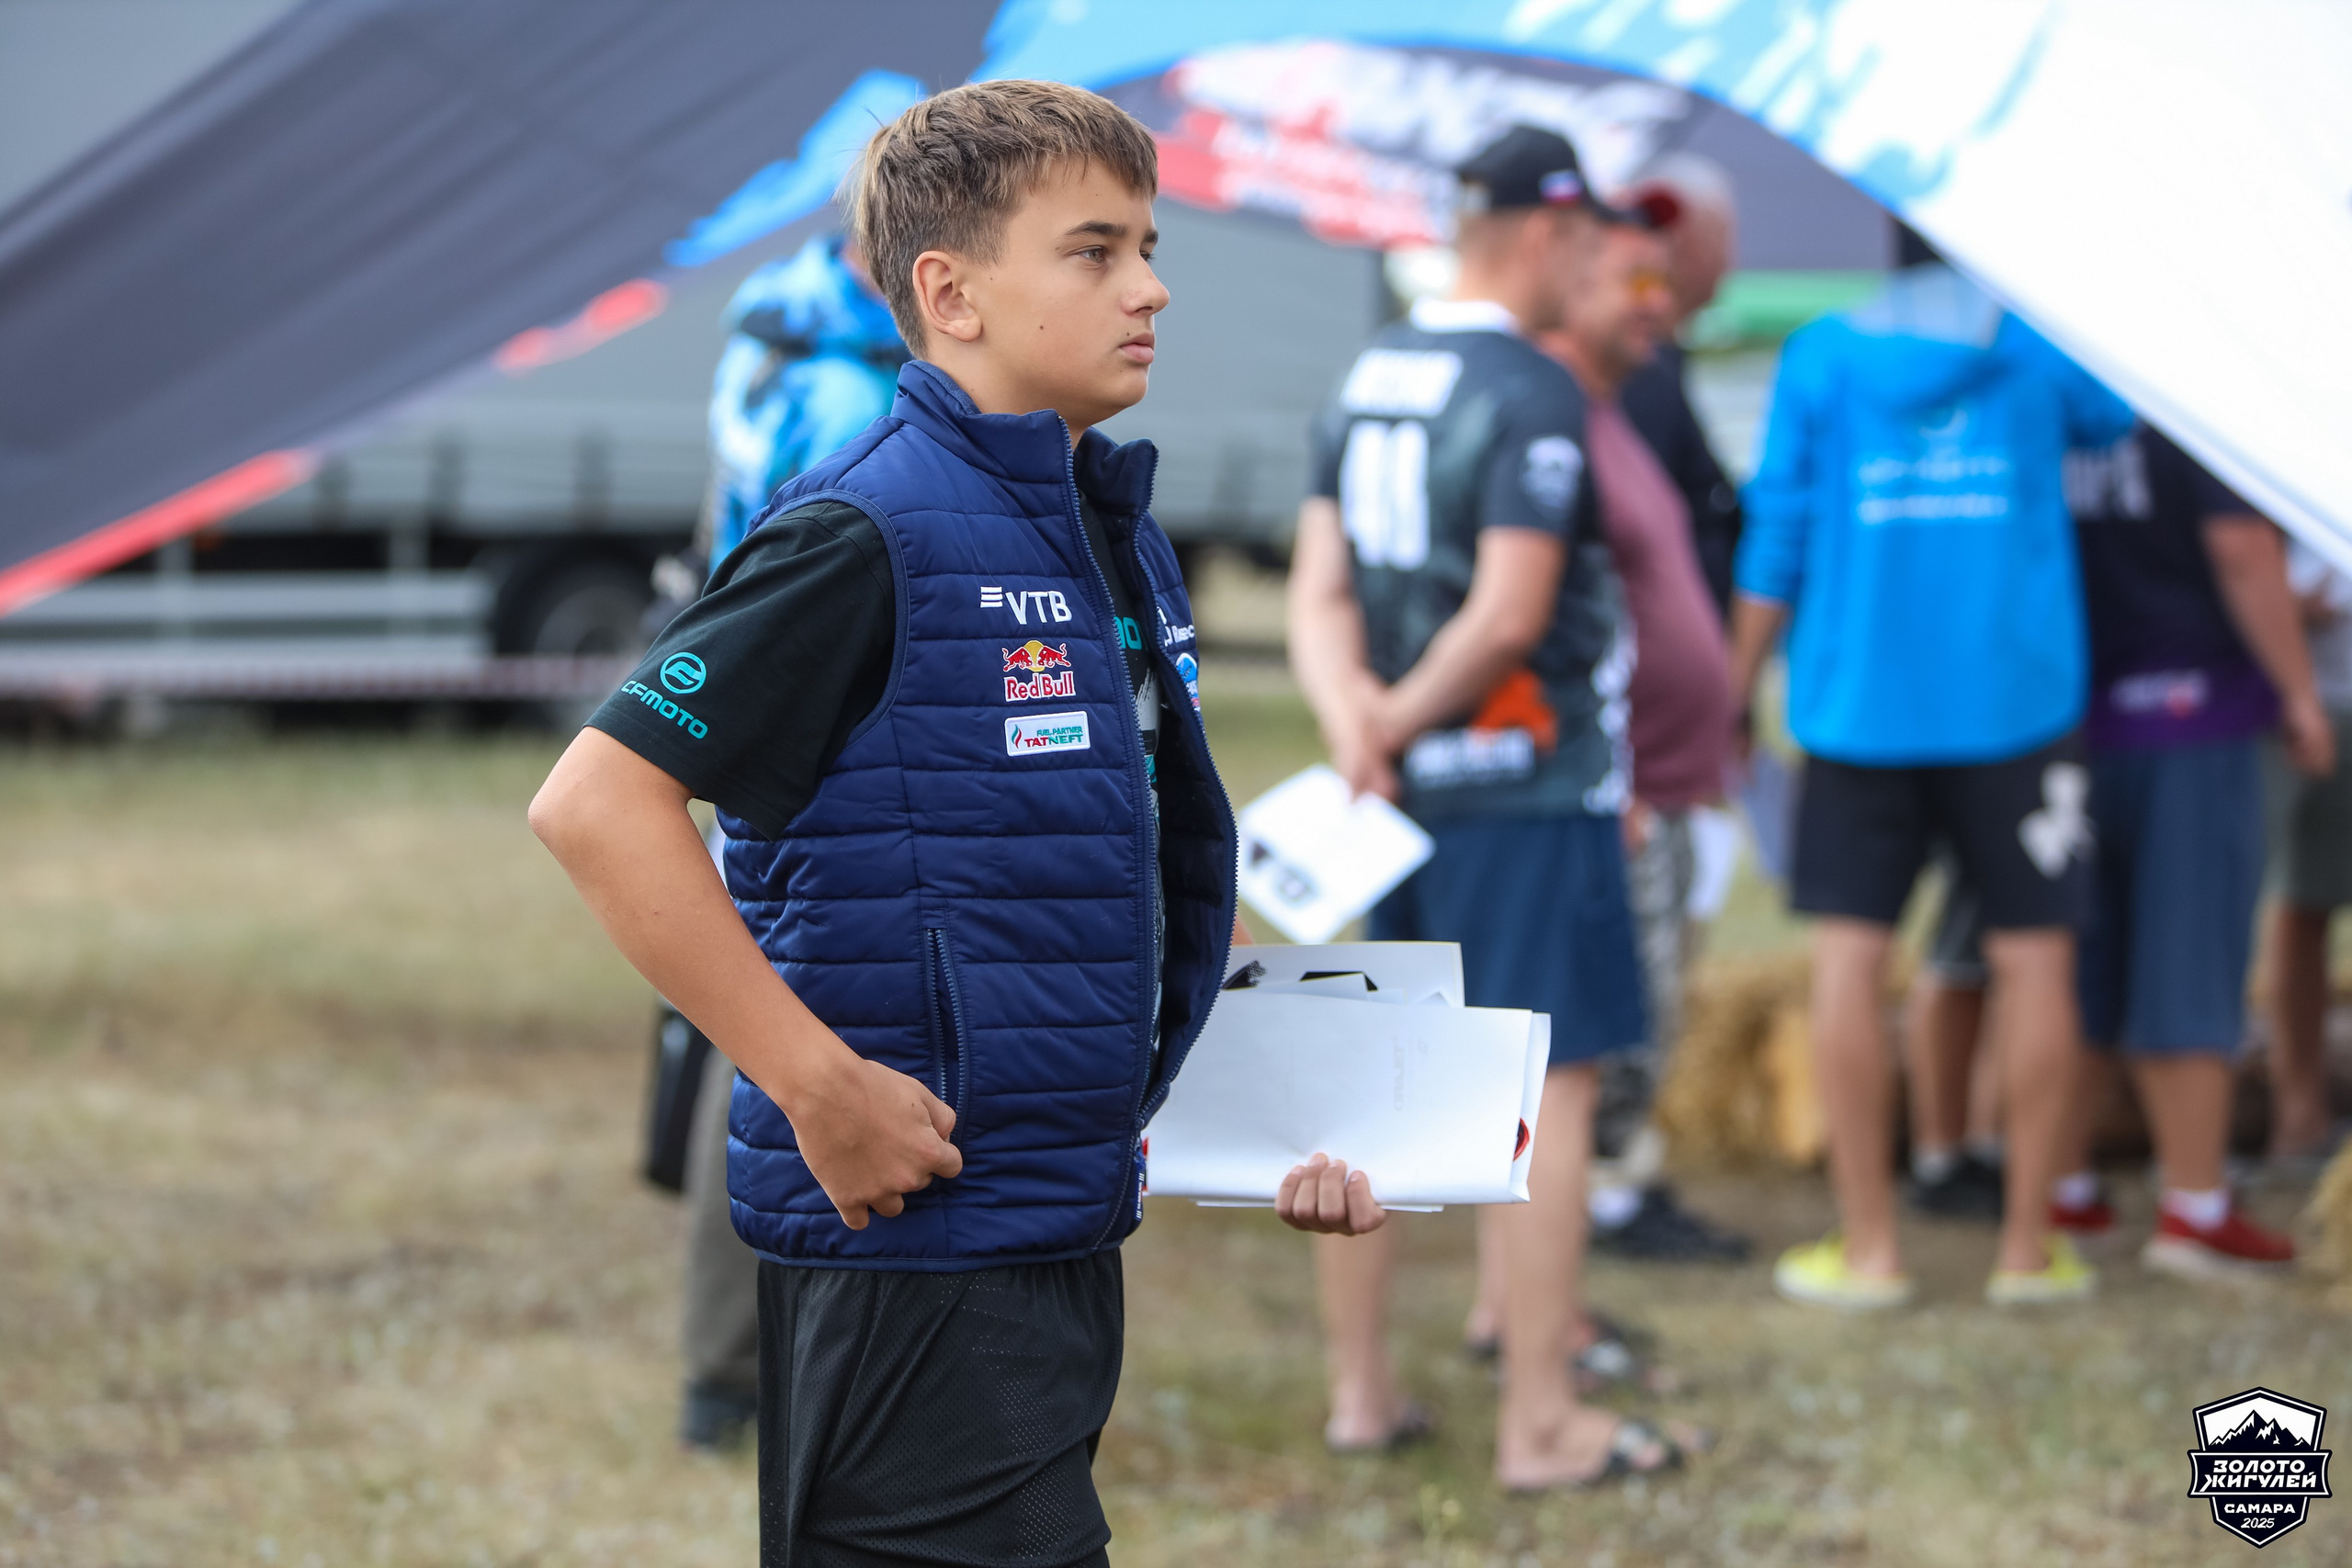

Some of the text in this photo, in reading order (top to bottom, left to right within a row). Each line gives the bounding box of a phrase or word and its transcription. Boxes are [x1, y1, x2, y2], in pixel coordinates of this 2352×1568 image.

[1005, 591, 1073, 625] VTB
[1005, 671, 1074, 700] Red Bull
[621, 680, 708, 739] CFMOTO
[1024, 734, 1084, 748] TATNEFT
[1036, 726, 1083, 737] FUEL PARTNER
